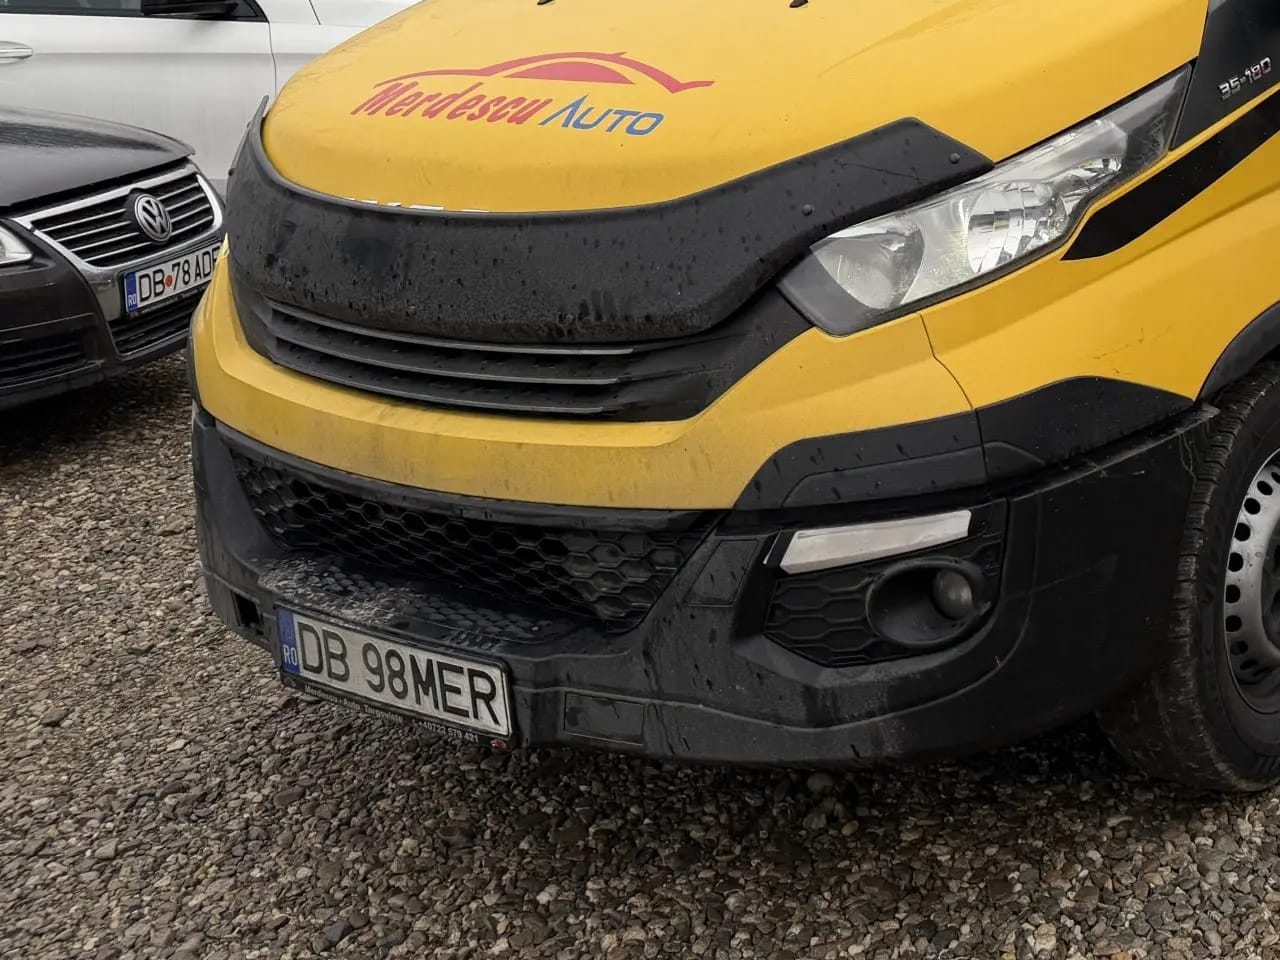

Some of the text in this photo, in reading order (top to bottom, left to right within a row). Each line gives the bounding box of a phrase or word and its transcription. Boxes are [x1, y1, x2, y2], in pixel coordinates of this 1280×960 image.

[1219, 56, 1272, 100] 35-180
[350, 81, 553, 125] Merdescu
[138, 268, 166, 303] DB
[171, 259, 191, 290] 78
[282, 644, 298, 667] RO
[297, 620, 350, 683] DB
